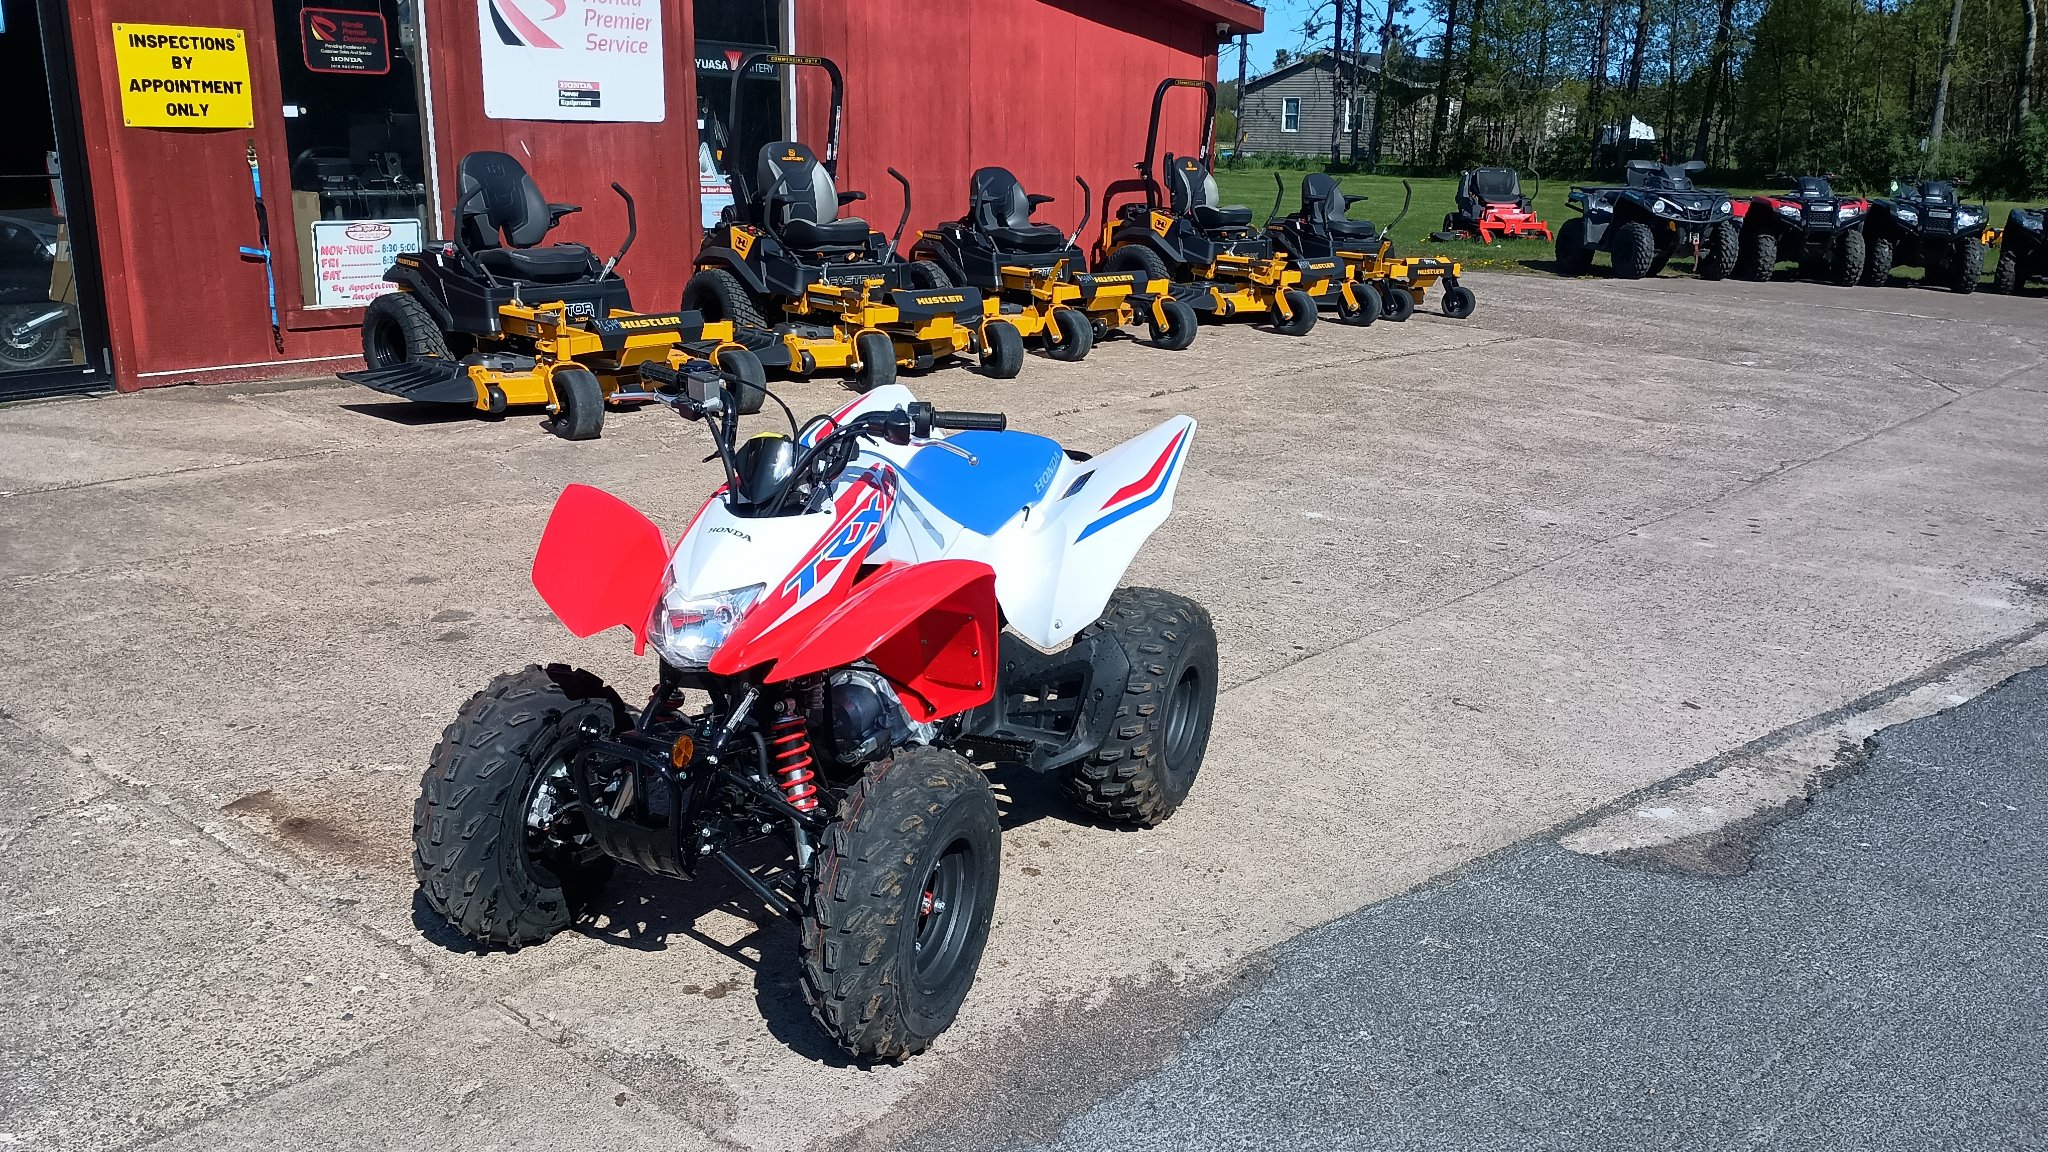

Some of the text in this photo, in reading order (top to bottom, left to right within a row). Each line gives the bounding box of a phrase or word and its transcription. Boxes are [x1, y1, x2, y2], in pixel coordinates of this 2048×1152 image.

[584, 8, 652, 31] Premier
[129, 33, 235, 51] INSPECTIONS
[586, 32, 648, 54] Service
[172, 55, 193, 69] BY
[695, 58, 728, 70] YUASA
[129, 79, 243, 94] APPOINTMENT
[166, 103, 209, 116] ONLY
[321, 258, 339, 268] FRI
[1309, 262, 1335, 270] HUSTLER
[322, 271, 341, 280] SAT
[1093, 274, 1134, 283] HUSTLER
[915, 294, 964, 305] HUSTLER
[619, 316, 681, 329] HUSTLER
[1033, 450, 1060, 495] HONDA
[708, 526, 753, 543] HONDA
[781, 492, 882, 600] TRX
